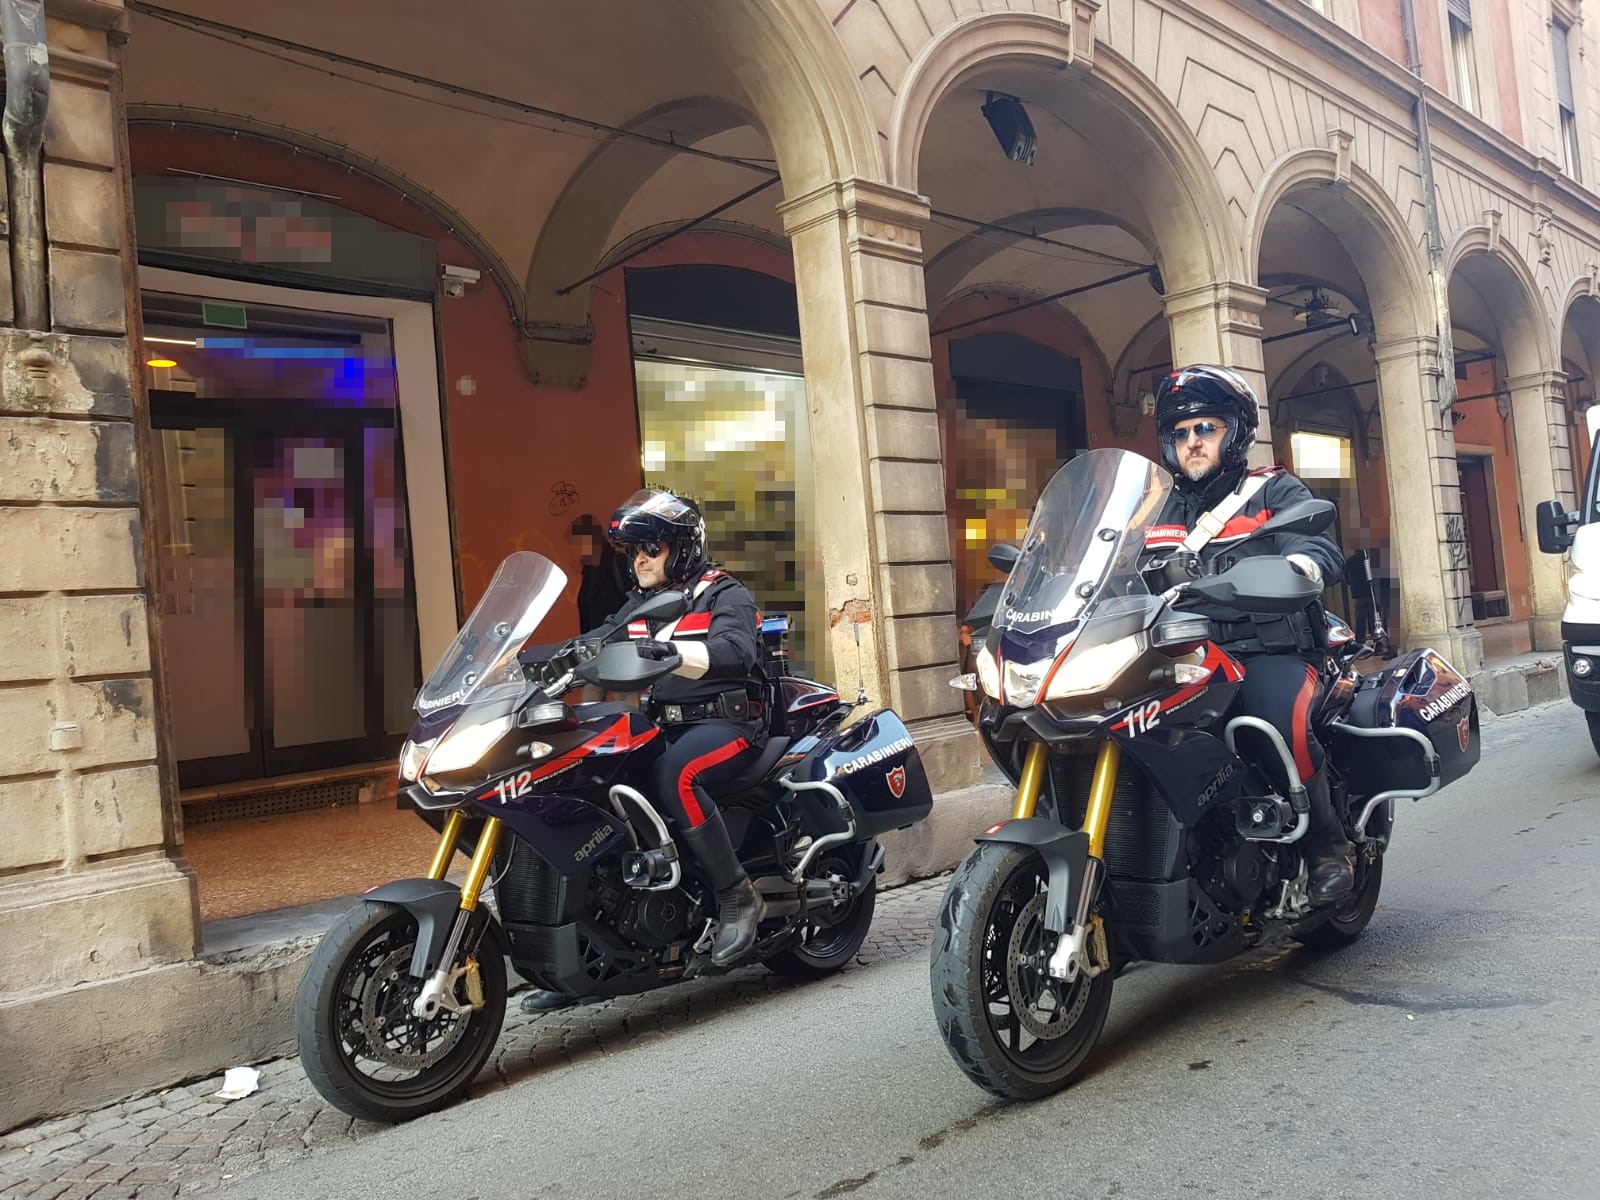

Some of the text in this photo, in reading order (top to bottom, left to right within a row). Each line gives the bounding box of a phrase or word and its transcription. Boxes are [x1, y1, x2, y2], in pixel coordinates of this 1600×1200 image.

[1123, 700, 1161, 739] 112
[1420, 681, 1473, 722] CARABINIERI
[843, 736, 914, 774] CARABINIERI
[494, 771, 533, 805] 112
[1197, 763, 1234, 807] aprilia
[574, 824, 615, 862] aprilia
